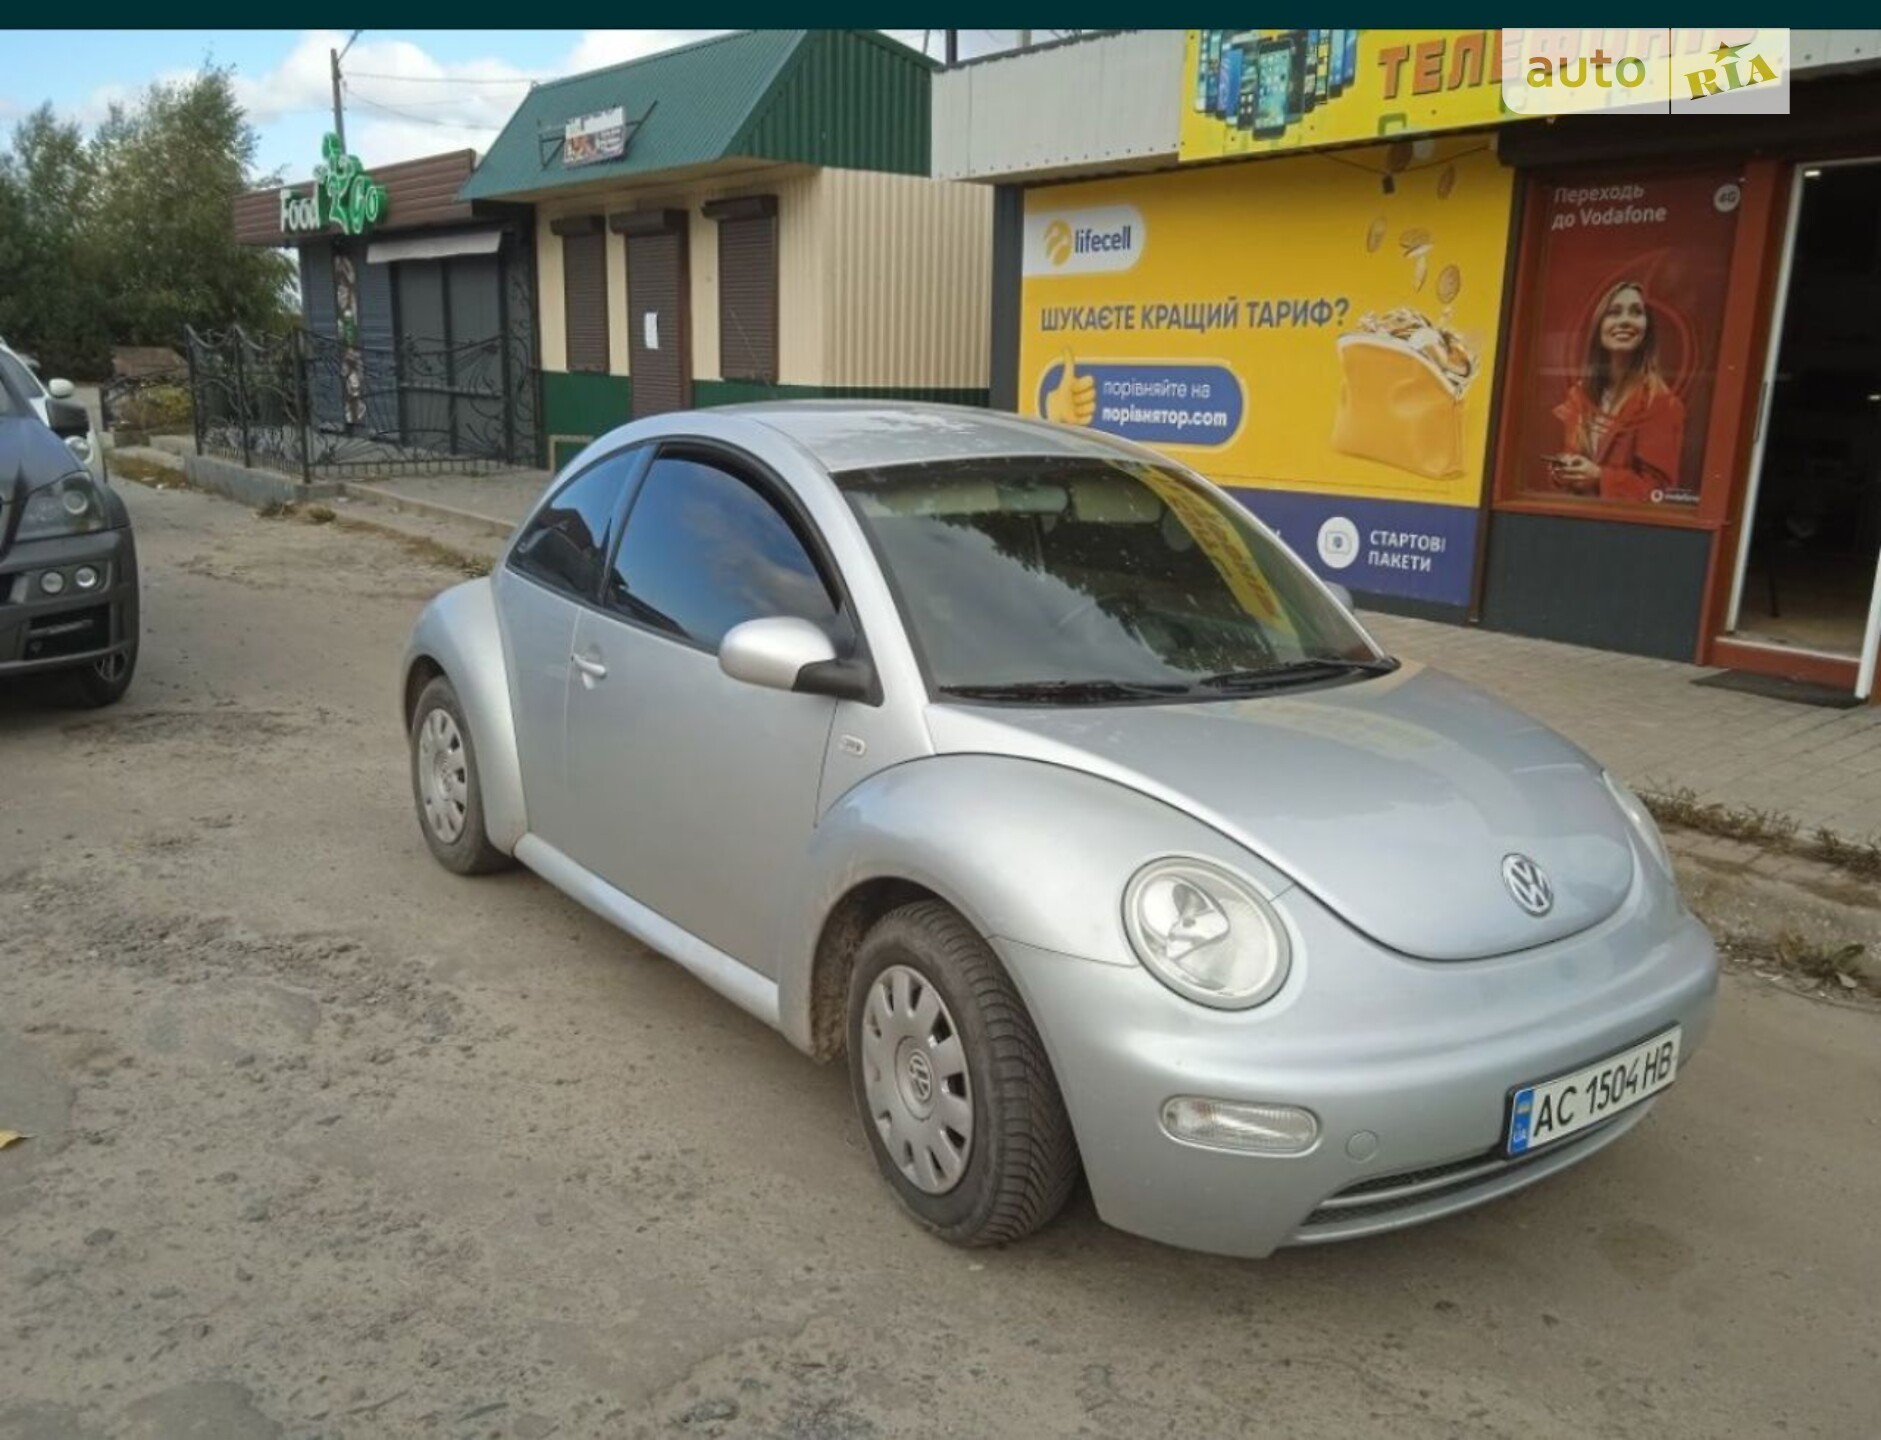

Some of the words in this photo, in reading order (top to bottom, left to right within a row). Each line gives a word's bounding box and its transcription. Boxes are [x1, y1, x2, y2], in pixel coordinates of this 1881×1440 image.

[280, 182, 320, 232] Food
[1554, 184, 1645, 206] Переходь
[1551, 212, 1575, 231] до
[1579, 206, 1667, 226] Vodafone
[1075, 226, 1131, 253] lifecell
[1041, 304, 1135, 331] ШУКАЄТЕ
[1141, 296, 1238, 333] КРАЩИЙ
[1246, 297, 1349, 328] ТАРИФ?
[1103, 376, 1187, 399] порівняйте
[1191, 381, 1211, 398] на
[1102, 405, 1227, 429] порівнятор.com
[1370, 530, 1446, 553] СТАРТОВІ
[1368, 550, 1431, 572] ПАКЕТИ
[1533, 1085, 1578, 1137] AC
[1586, 1057, 1640, 1115] 1504
[1643, 1040, 1673, 1090] HB
